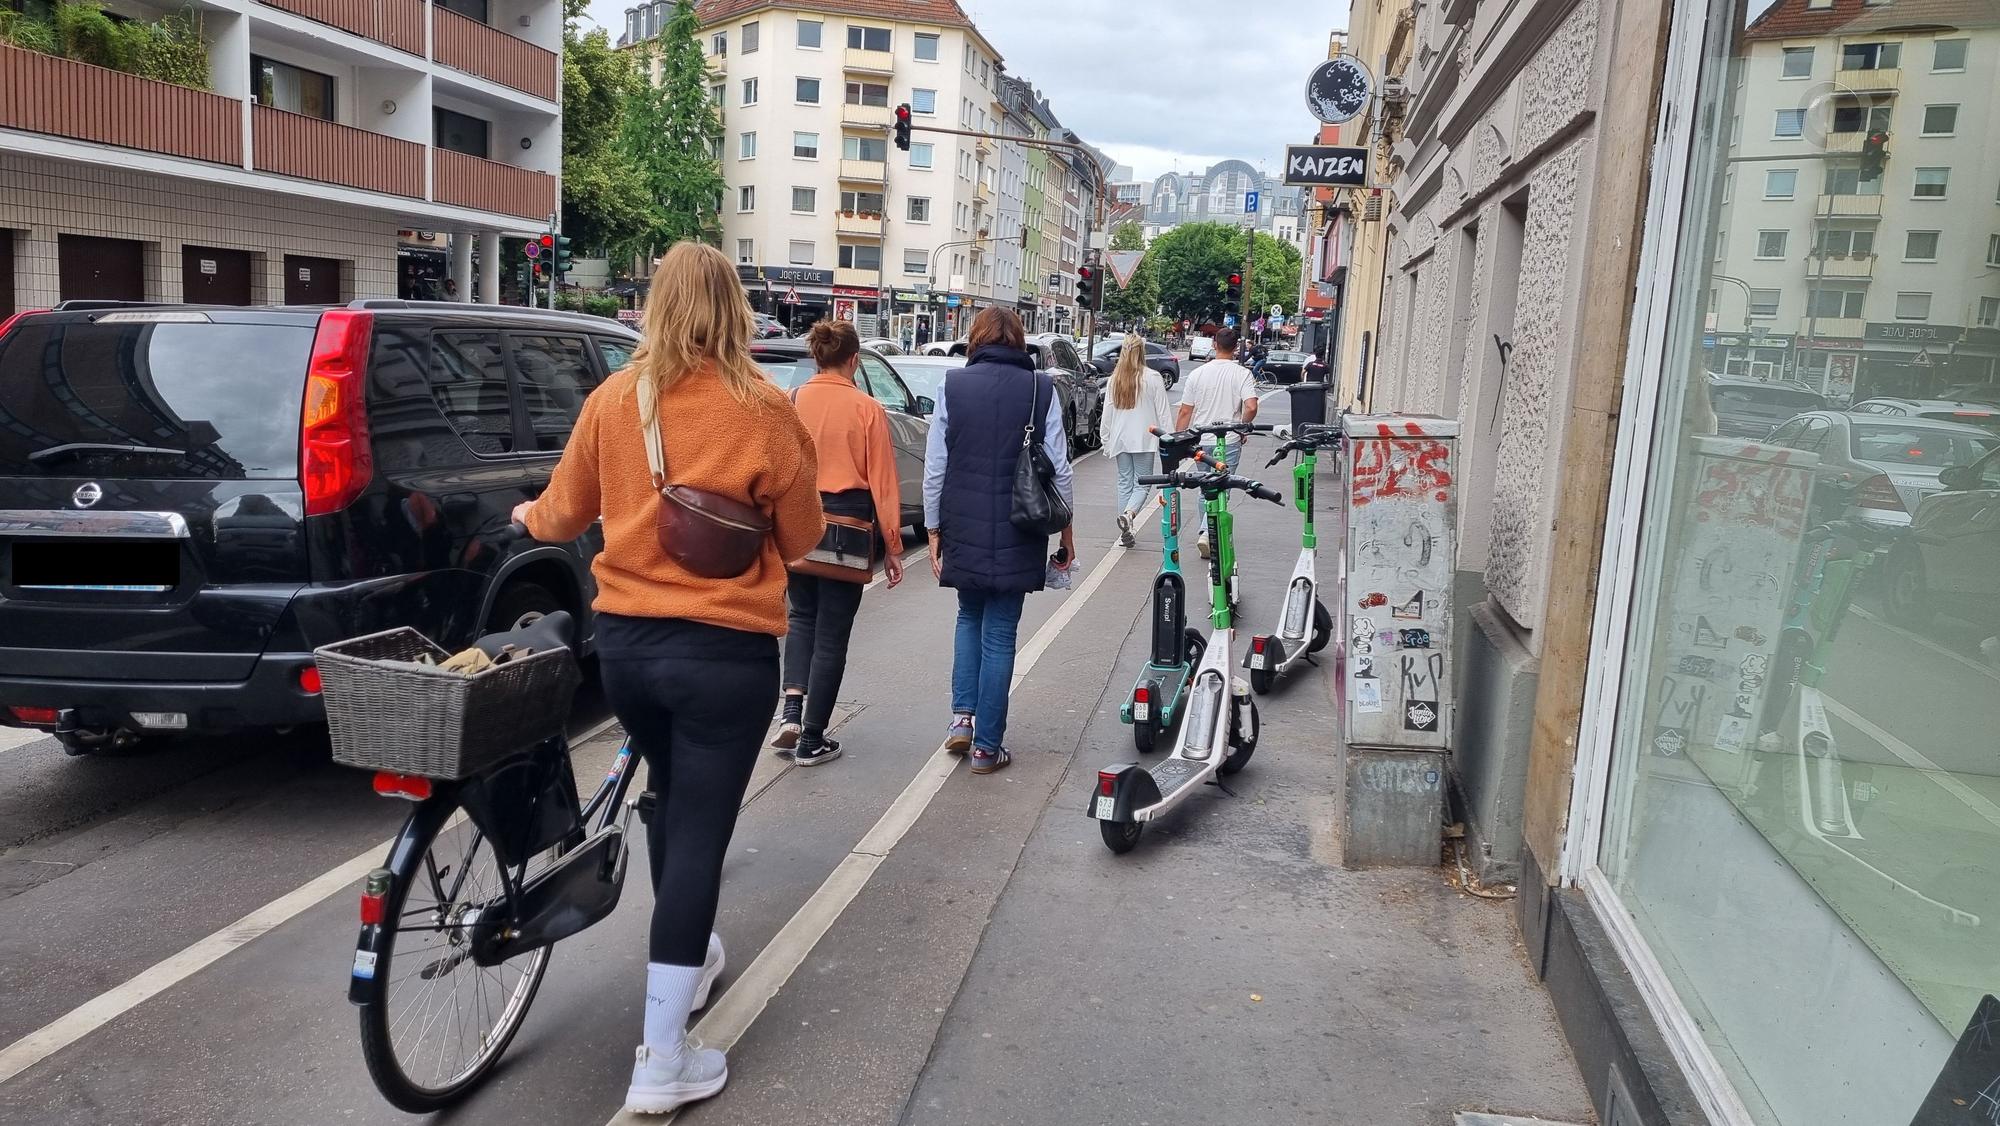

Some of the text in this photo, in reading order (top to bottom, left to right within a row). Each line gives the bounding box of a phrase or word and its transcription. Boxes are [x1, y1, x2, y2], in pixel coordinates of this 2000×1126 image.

[1289, 154, 1363, 177] KAIZEN
[803, 271, 821, 282] LADE
[1098, 798, 1112, 808] 673
